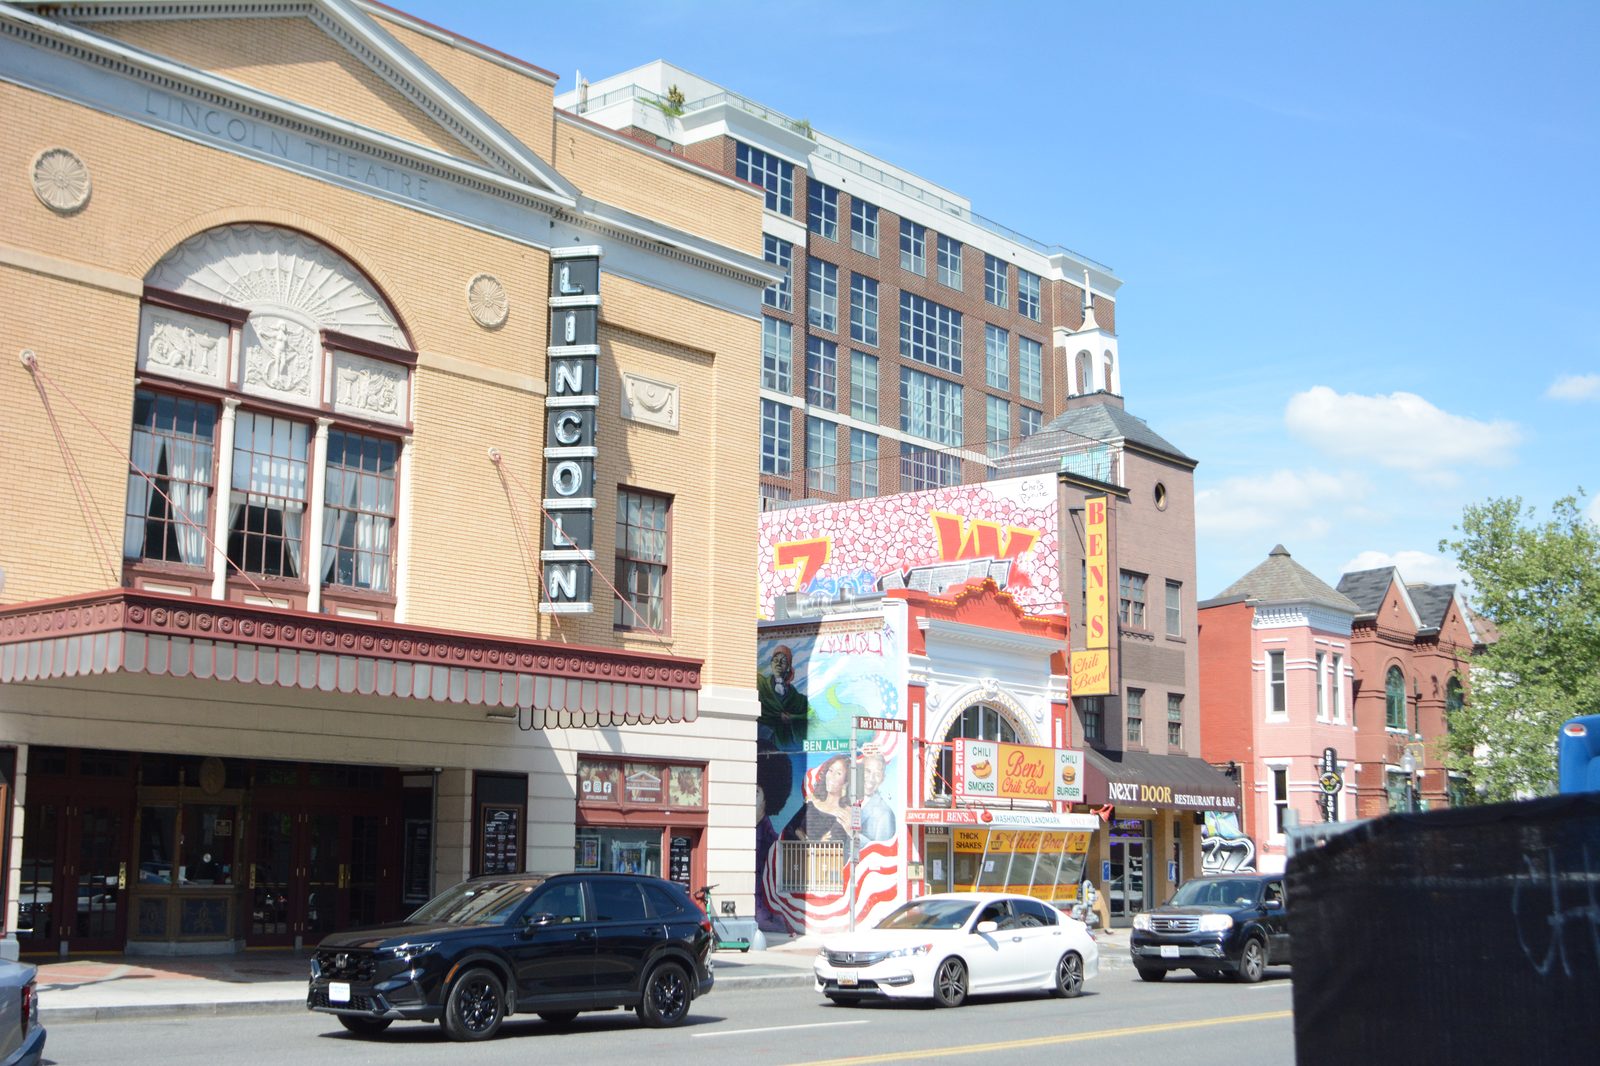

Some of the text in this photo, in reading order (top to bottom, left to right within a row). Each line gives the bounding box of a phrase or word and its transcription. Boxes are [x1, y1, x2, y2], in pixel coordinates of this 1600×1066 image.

[145, 89, 429, 201] LINCOLN THEATRE
[551, 261, 584, 599] LINCOLN
[1088, 502, 1105, 639] BEN'S
[1073, 653, 1099, 674] Chili
[1073, 665, 1107, 691] Bowl
[803, 740, 822, 751] BEN
[826, 740, 839, 751] ALI
[972, 746, 992, 757] CHILI
[954, 740, 964, 795] BEN'S
[1005, 750, 1045, 779] Ben's
[1060, 754, 1078, 764] CHILI
[967, 781, 995, 792] SMOKES
[1001, 776, 1051, 796] Chili Bowl
[1056, 786, 1080, 797] BURGER
[1140, 784, 1172, 803] DOOR
[1174, 793, 1215, 806] RESTAURANT
[1215, 796, 1222, 806] &
[1222, 796, 1236, 807] BAR
[994, 815, 1060, 825] WASHINGTON LANDMARK
[955, 841, 982, 849] SHAKES
[959, 832, 979, 840] THICK
